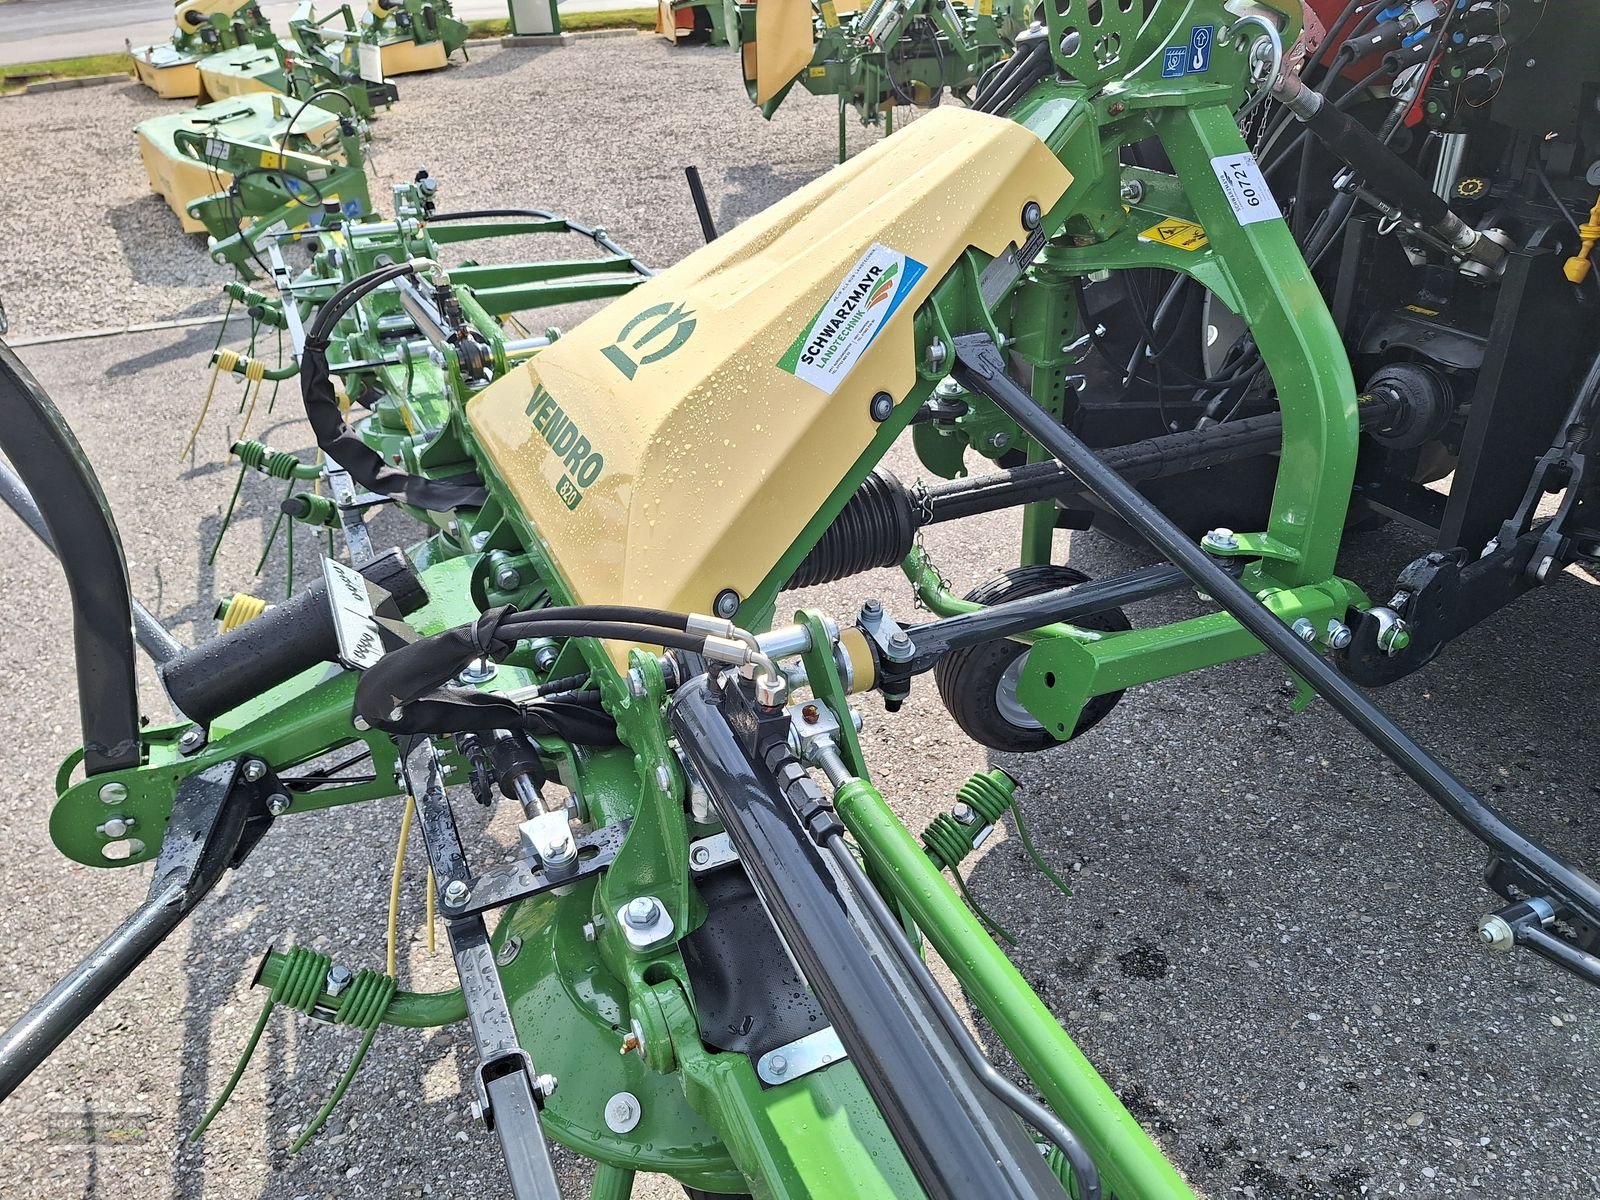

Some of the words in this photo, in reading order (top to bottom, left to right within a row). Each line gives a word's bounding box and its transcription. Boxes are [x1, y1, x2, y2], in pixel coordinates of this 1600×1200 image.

[1229, 162, 1260, 207] 60721
[801, 266, 884, 365] SCHWARZMAYR
[815, 309, 867, 369] LANDTECHNIK
[525, 384, 604, 488] VENDRO
[559, 481, 576, 506] 820
